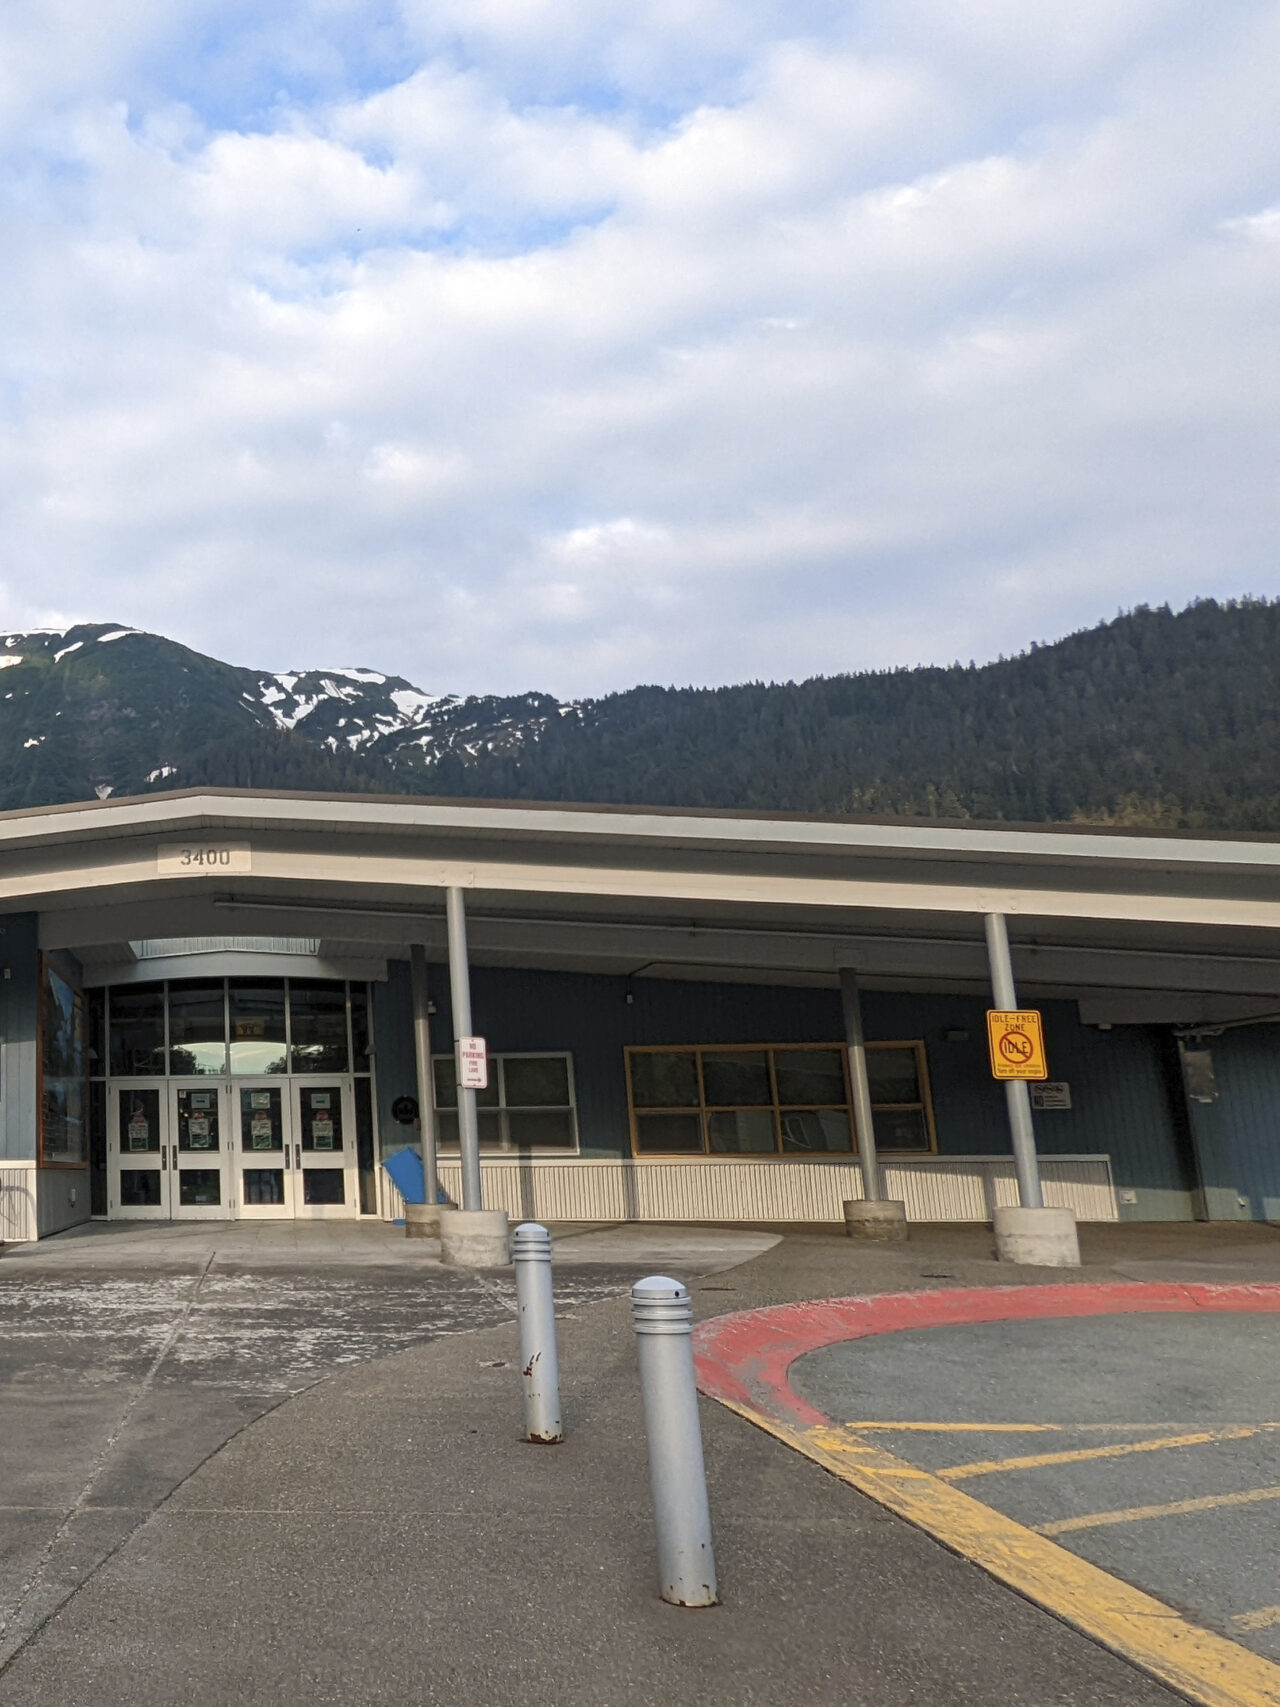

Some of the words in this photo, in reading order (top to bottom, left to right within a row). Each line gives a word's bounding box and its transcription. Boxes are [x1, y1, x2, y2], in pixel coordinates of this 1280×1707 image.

[180, 849, 231, 866] 3400
[992, 1014, 1037, 1023] IDLE-FREE
[1004, 1023, 1025, 1032] ZONE
[1004, 1041, 1029, 1054] IDLE
[462, 1051, 484, 1059] PARKING
